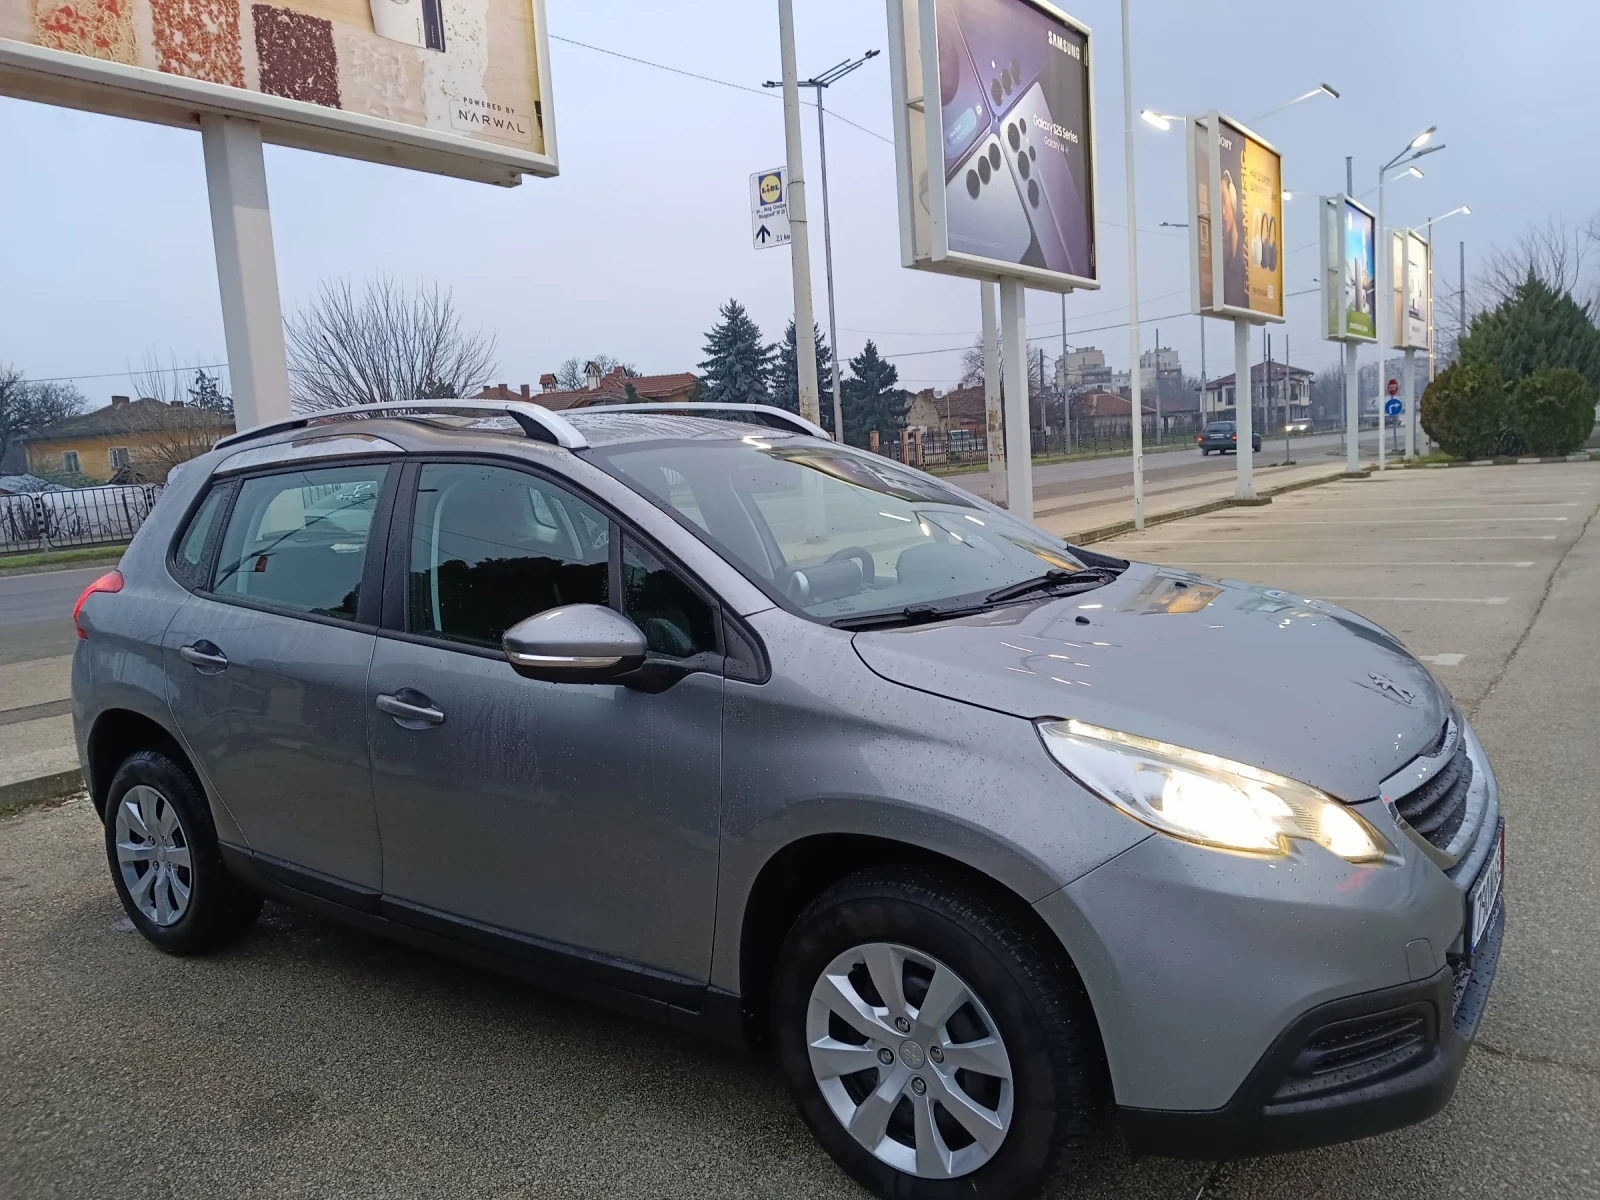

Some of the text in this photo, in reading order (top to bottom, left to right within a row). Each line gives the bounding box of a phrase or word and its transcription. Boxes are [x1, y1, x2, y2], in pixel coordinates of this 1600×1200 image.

[1048, 30, 1080, 60] SAMSUNG
[463, 96, 515, 115] POWERED BY
[458, 109, 526, 134] NARWAL
[1033, 113, 1079, 144] Galaxy S25 Series
[1043, 135, 1060, 153] Galaxy
